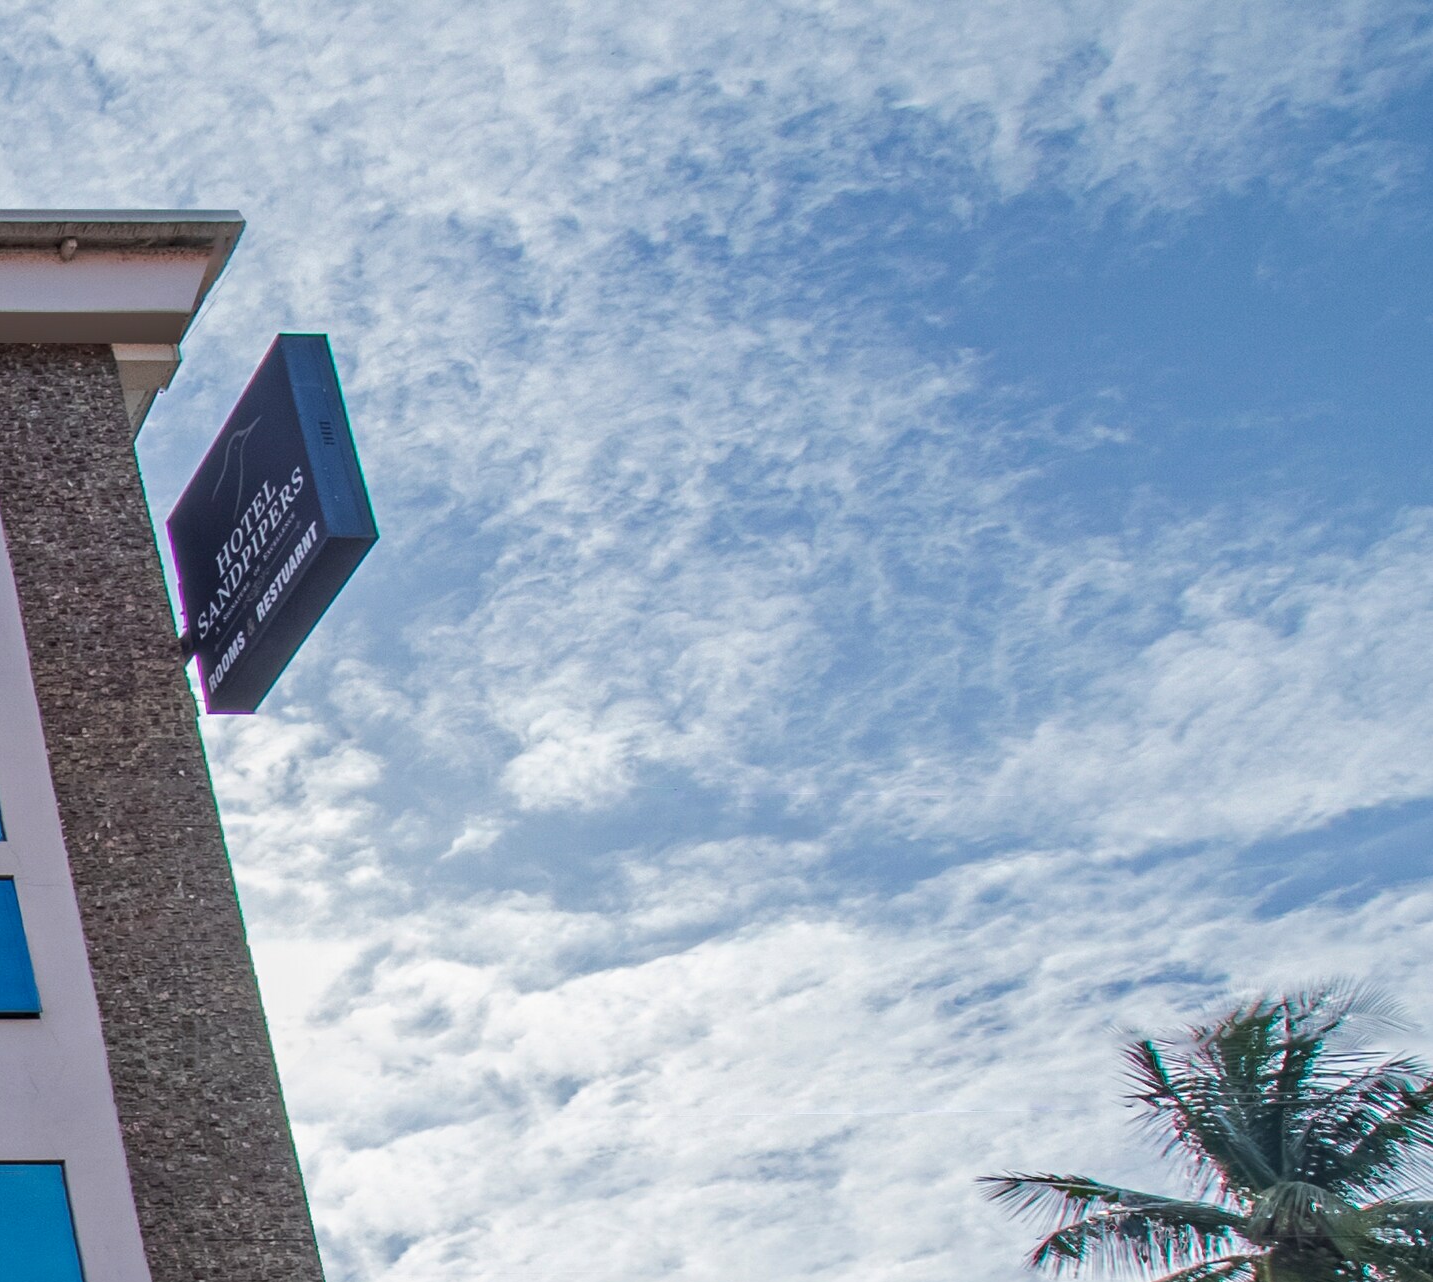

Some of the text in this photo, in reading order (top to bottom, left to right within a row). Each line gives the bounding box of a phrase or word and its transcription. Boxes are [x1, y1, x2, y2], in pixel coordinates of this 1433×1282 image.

[197, 466, 305, 640] SANDPIPERS
[215, 480, 277, 578] HOTEL
[207, 630, 247, 694] ROOMS
